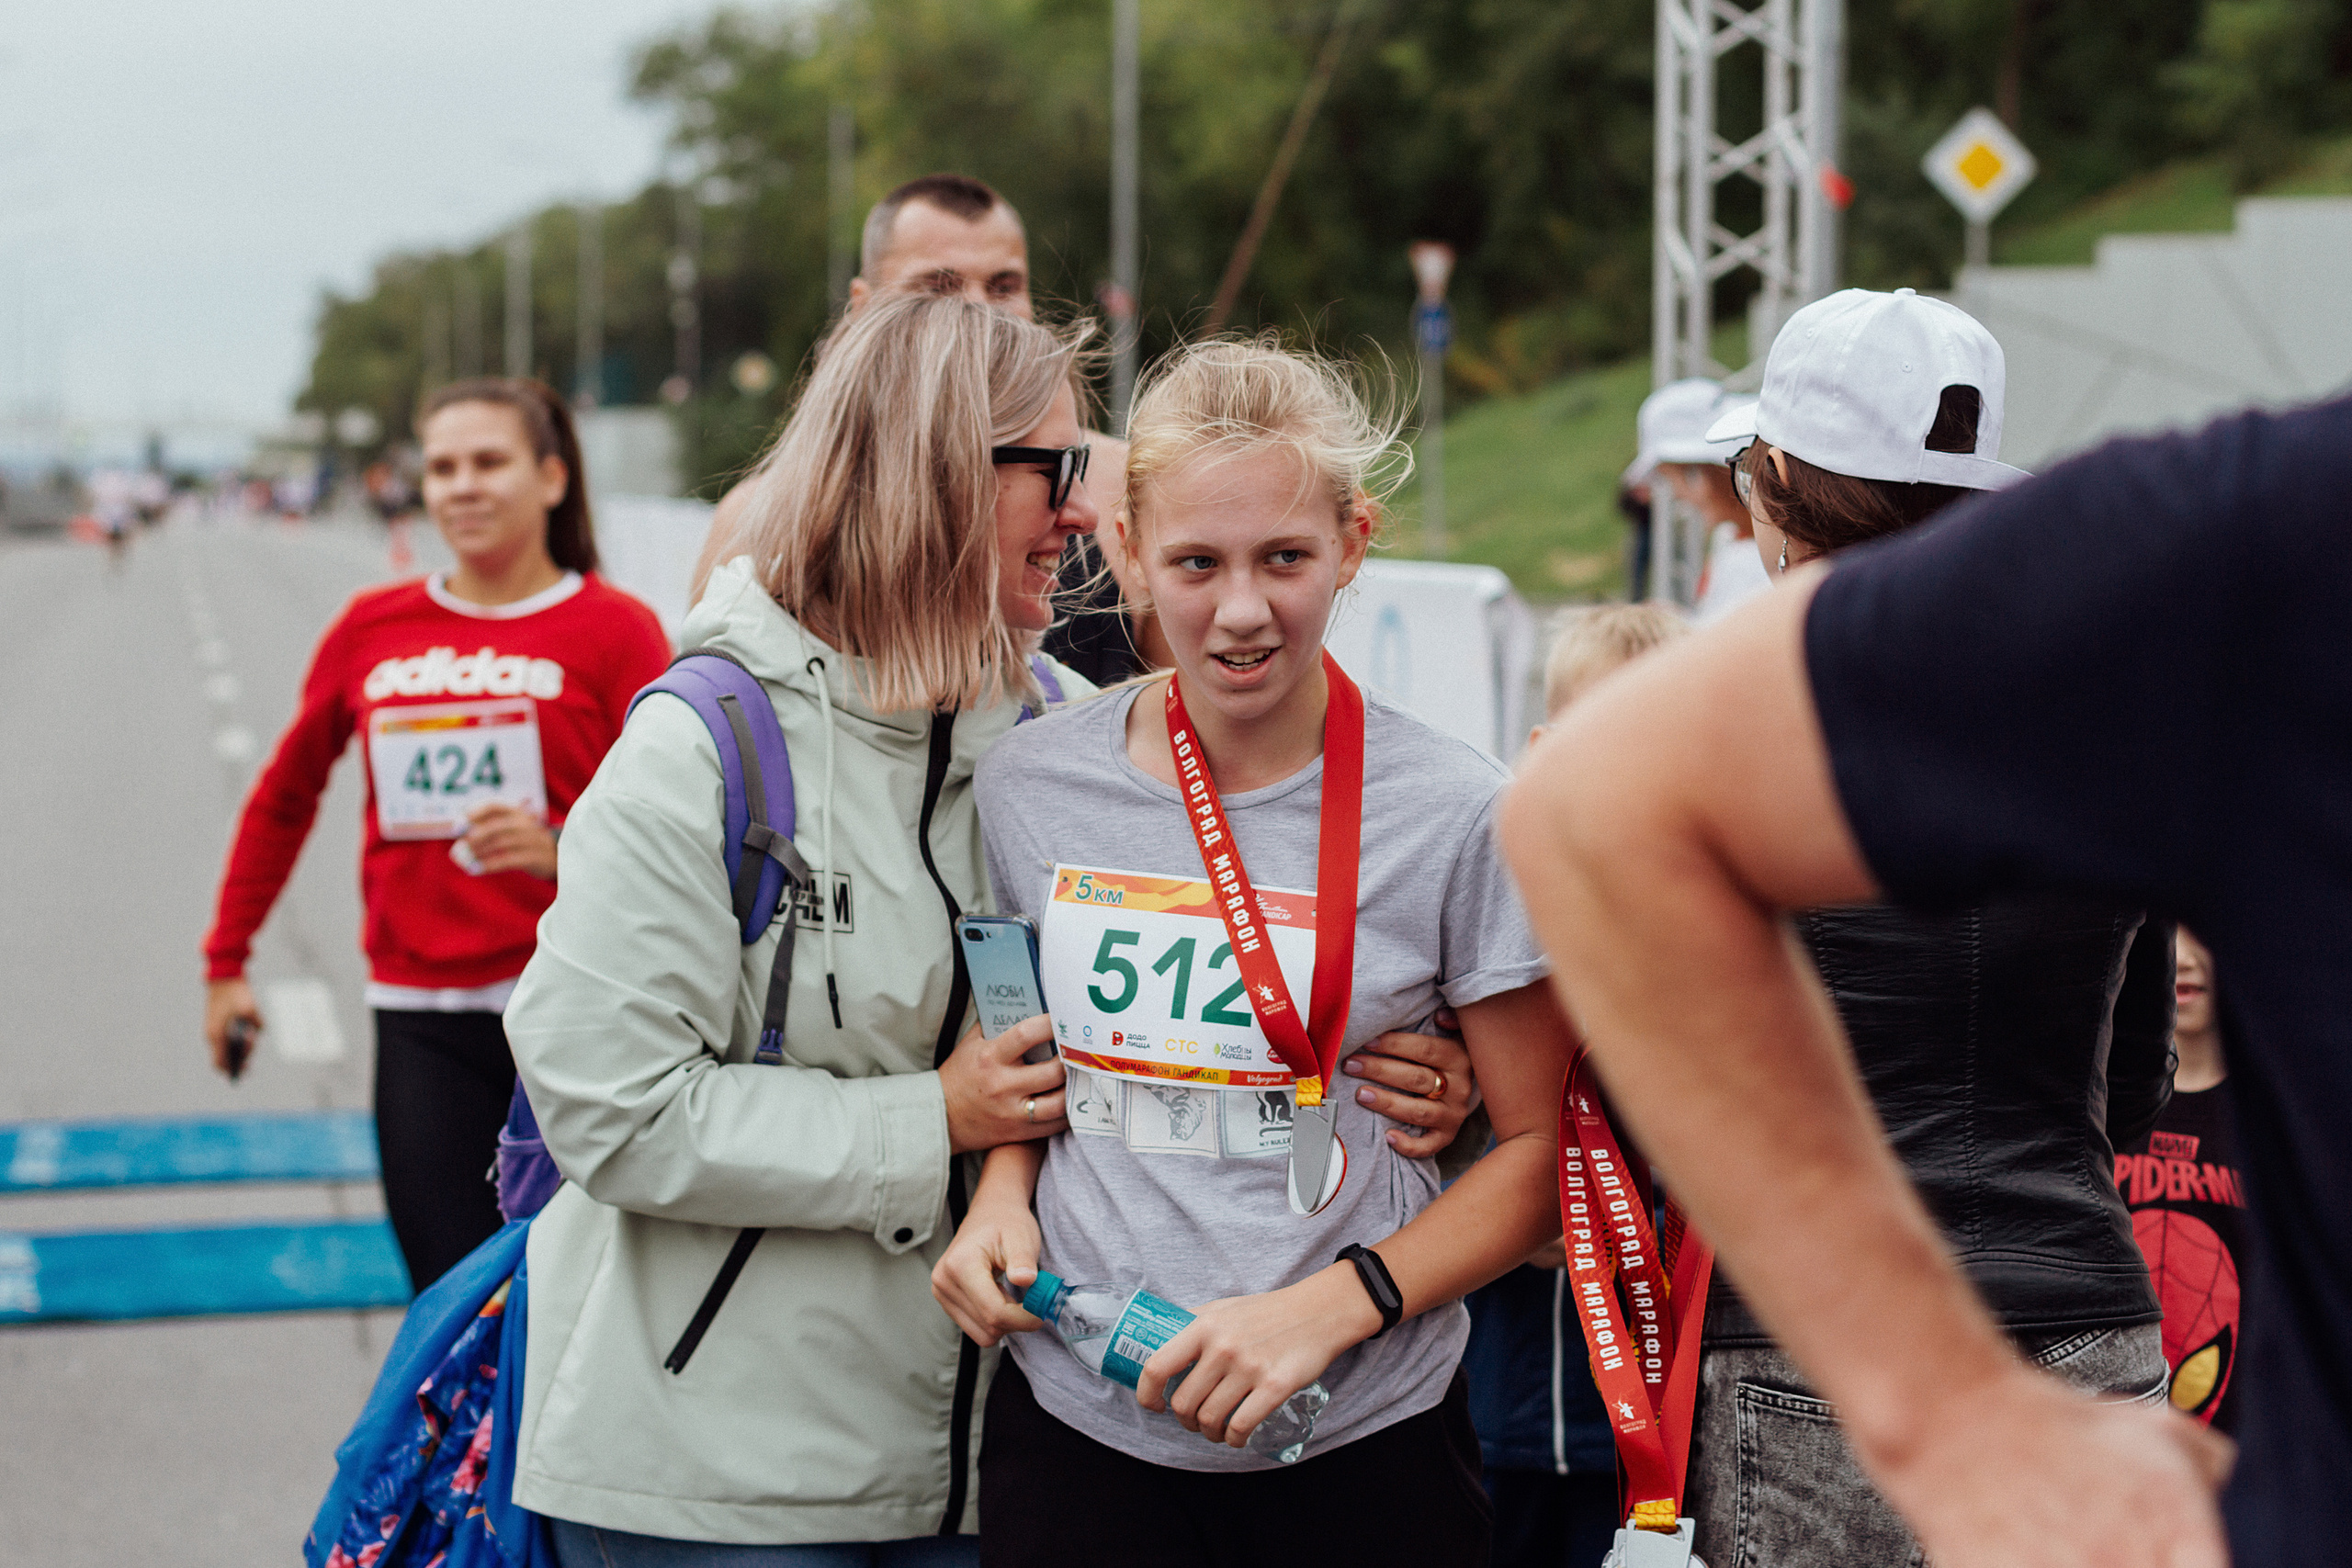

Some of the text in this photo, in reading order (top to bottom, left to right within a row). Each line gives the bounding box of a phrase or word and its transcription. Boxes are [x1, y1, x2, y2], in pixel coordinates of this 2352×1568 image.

[364, 646, 565, 701] adidas
[402, 740, 505, 797] 424
[1173, 729, 1261, 953] ВОЛГОГРАД МАРАФОН
[1261, 908, 1292, 920] ANDICAP
[1087, 929, 1252, 1027] 512
[1110, 1060, 1218, 1081] ПОЛУМАРАФОН ГАНДИКАП
[1126, 1041, 1150, 1049] ПИЦЦА
[1165, 1039, 1198, 1054] СТС
[1247, 1074, 1283, 1085] Volgograd
[1566, 1147, 1597, 1271] ВОЛГОГРАД
[1590, 1148, 1663, 1383] ВОЛГОГРАД МАРАФОН
[1581, 1281, 1623, 1371] МАРАФОН
